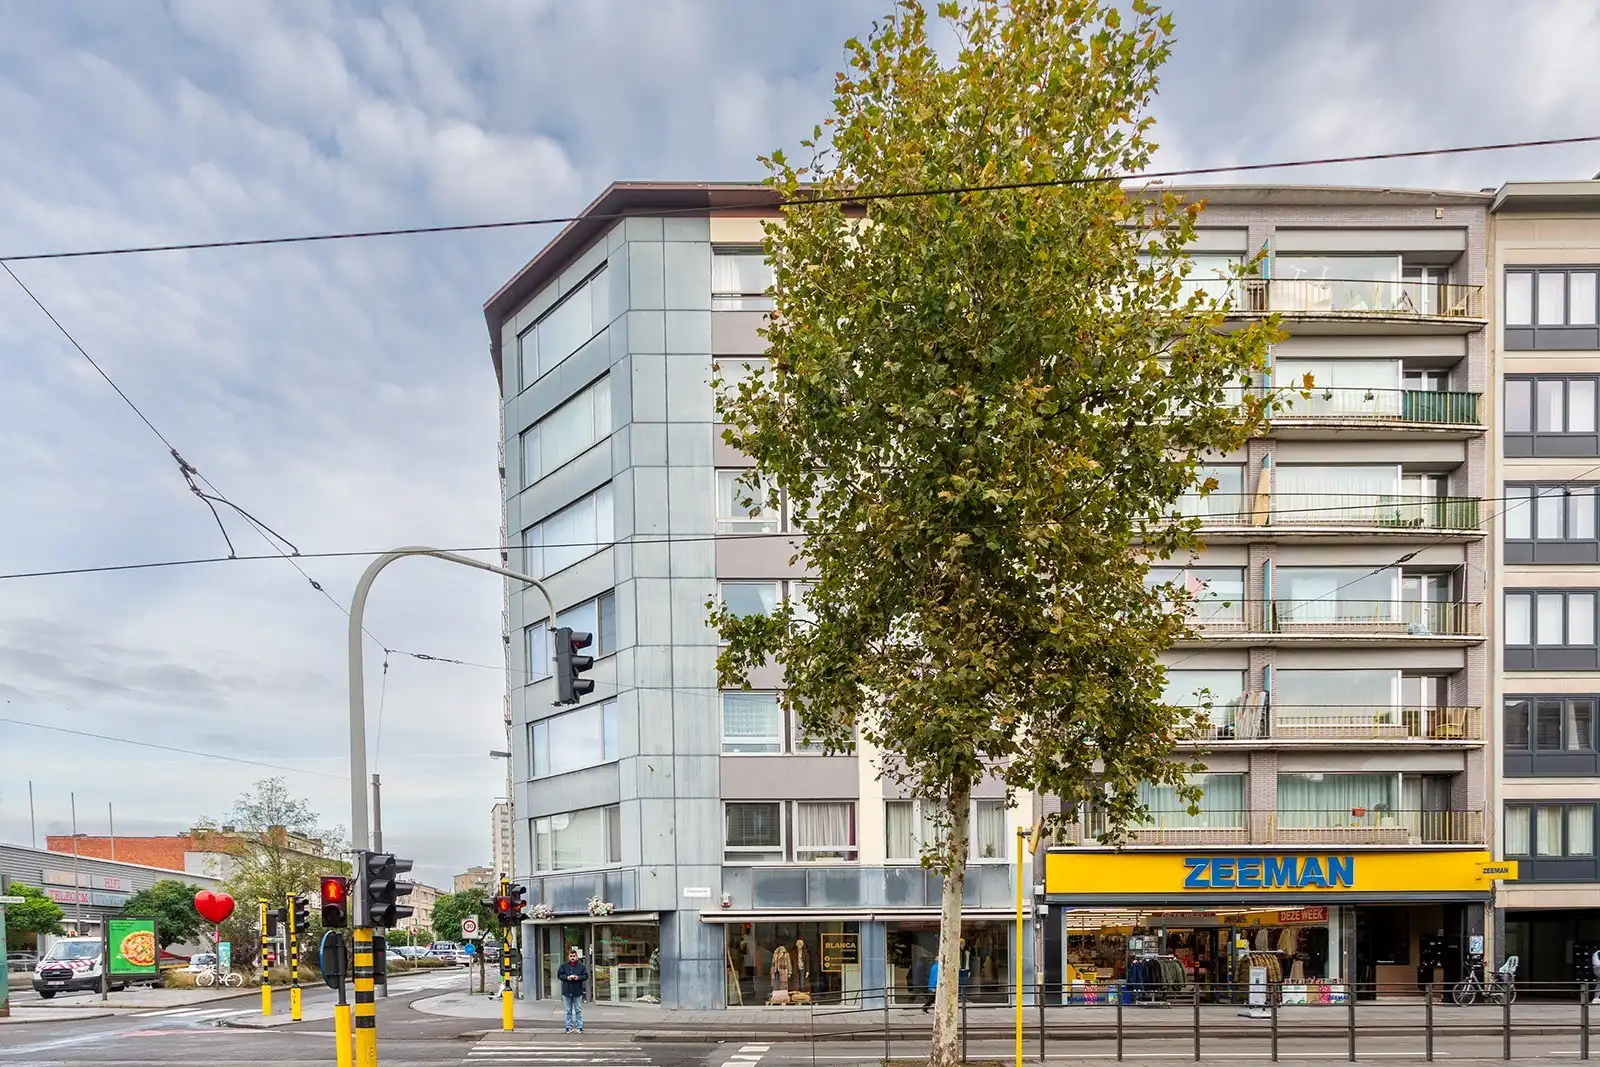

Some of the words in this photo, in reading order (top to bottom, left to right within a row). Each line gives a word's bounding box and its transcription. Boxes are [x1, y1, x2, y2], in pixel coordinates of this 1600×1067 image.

[1184, 856, 1355, 889] ZEEMAN
[104, 877, 120, 889] HIFI
[1281, 911, 1300, 921] DEZE
[1300, 909, 1324, 920] WEEK
